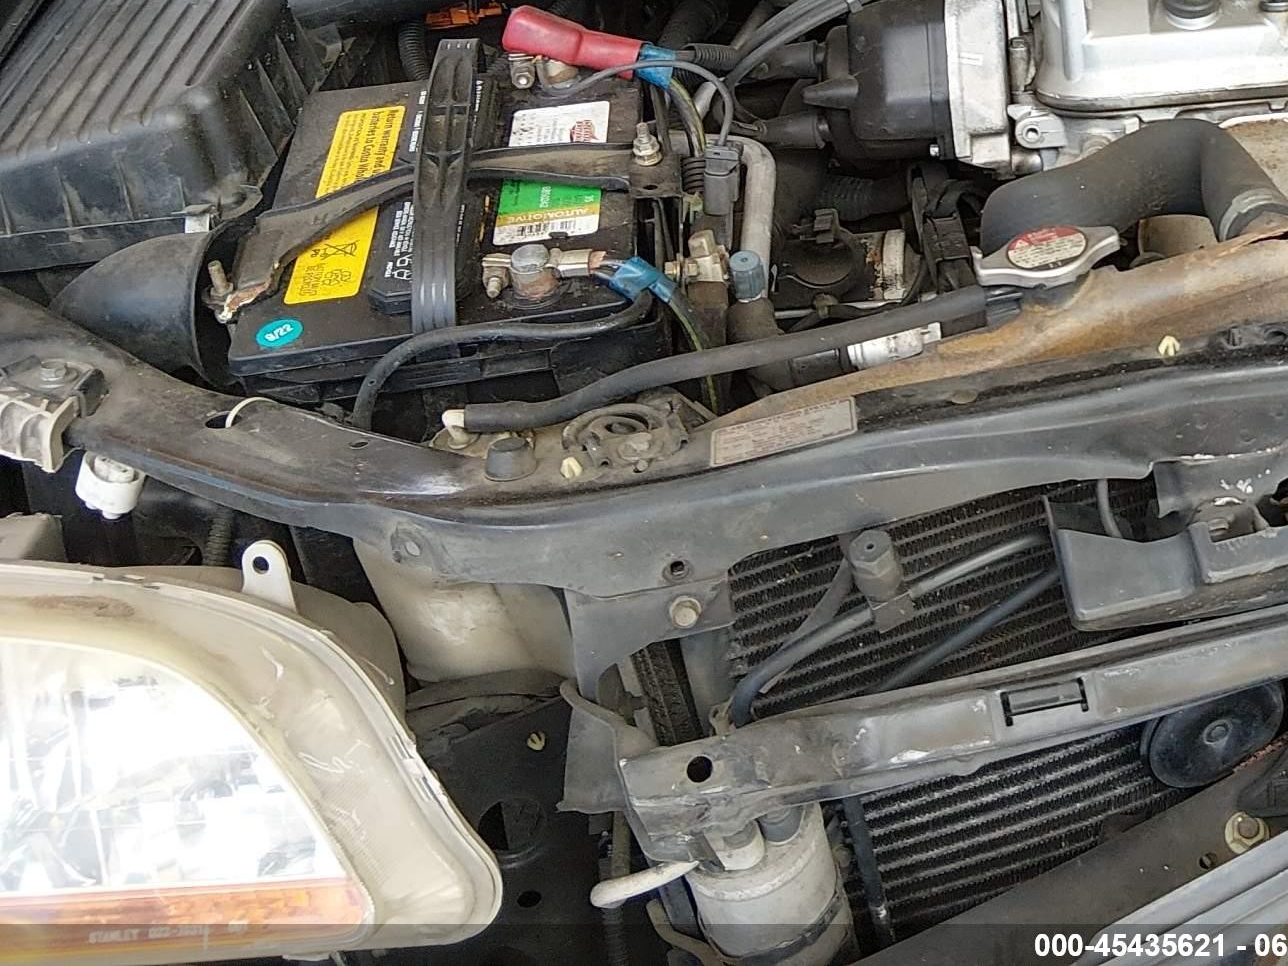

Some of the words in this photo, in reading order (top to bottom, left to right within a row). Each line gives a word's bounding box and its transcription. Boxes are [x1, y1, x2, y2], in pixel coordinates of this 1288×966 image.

[374, 129, 391, 157] warranty
[507, 207, 589, 223] AUTOMOTIVE
[310, 248, 321, 259] Pb
